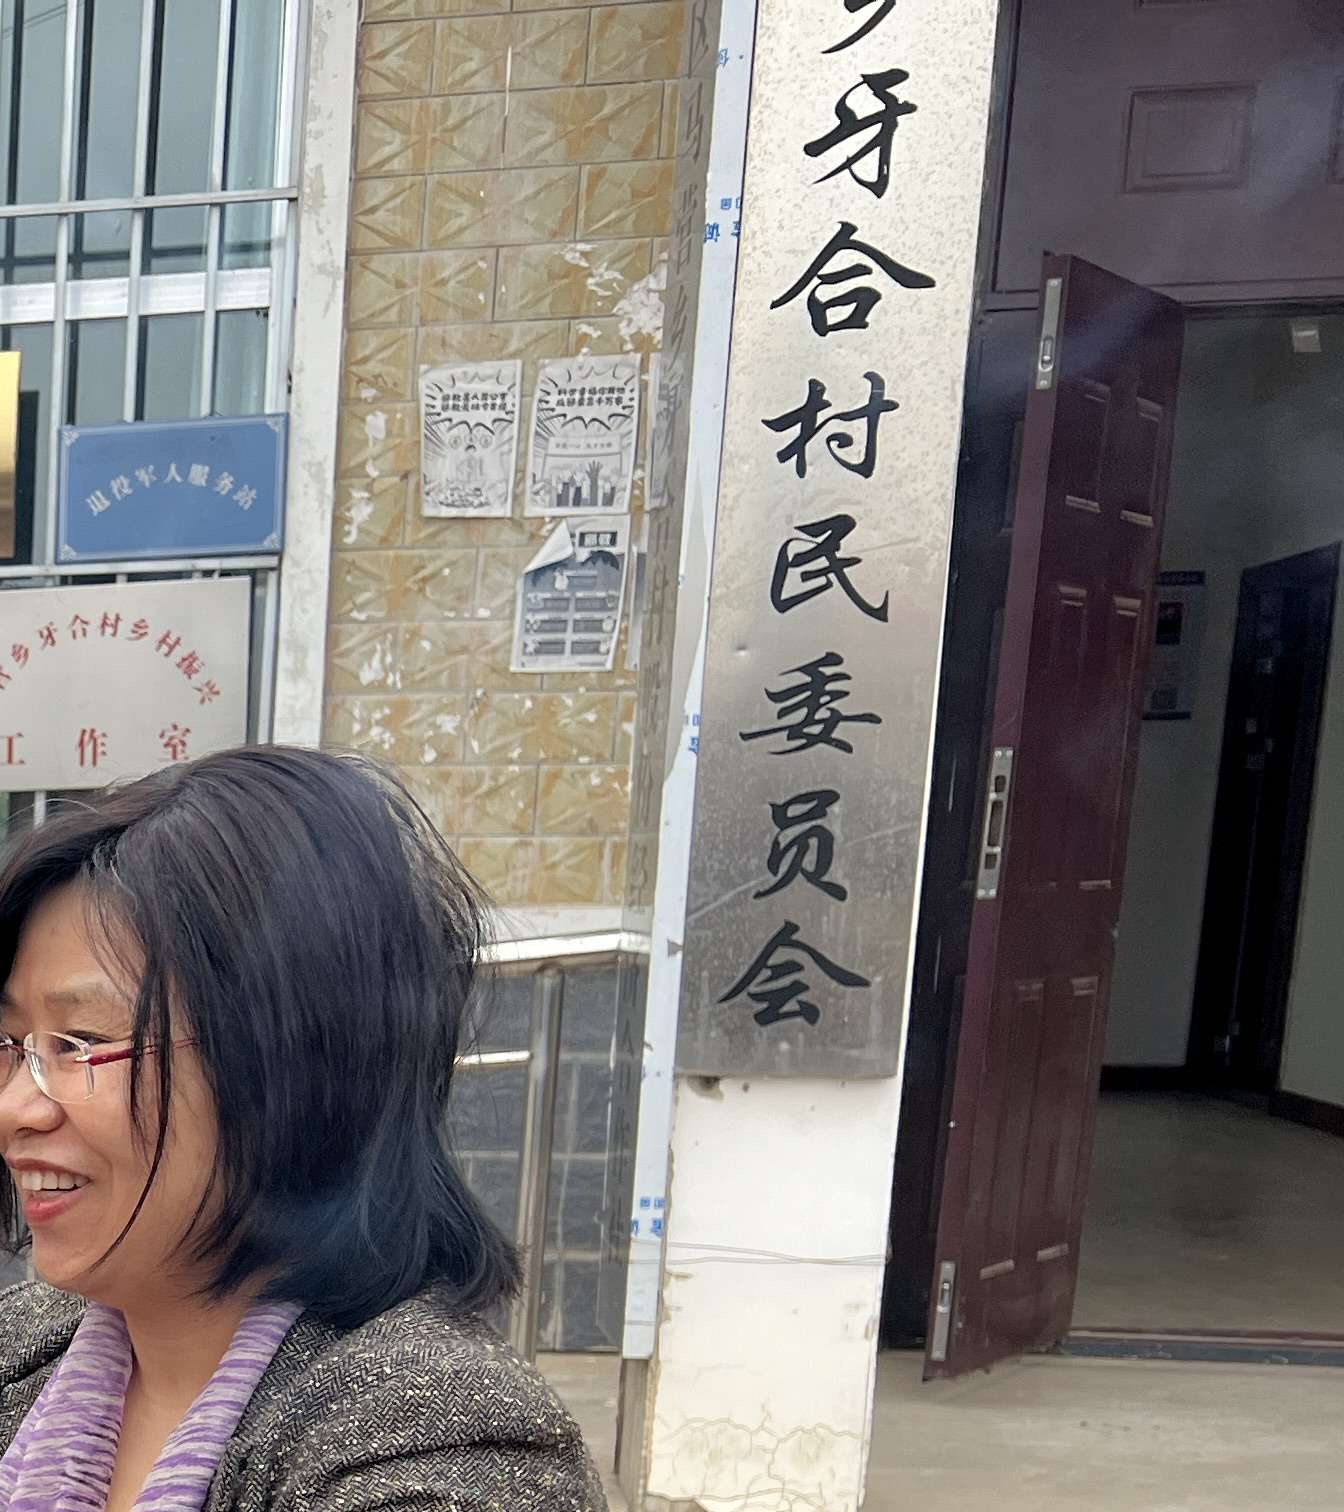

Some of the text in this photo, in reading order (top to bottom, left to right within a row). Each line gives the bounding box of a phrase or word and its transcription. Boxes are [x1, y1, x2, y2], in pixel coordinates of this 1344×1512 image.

[85, 461, 258, 517] 退役军人服务站
